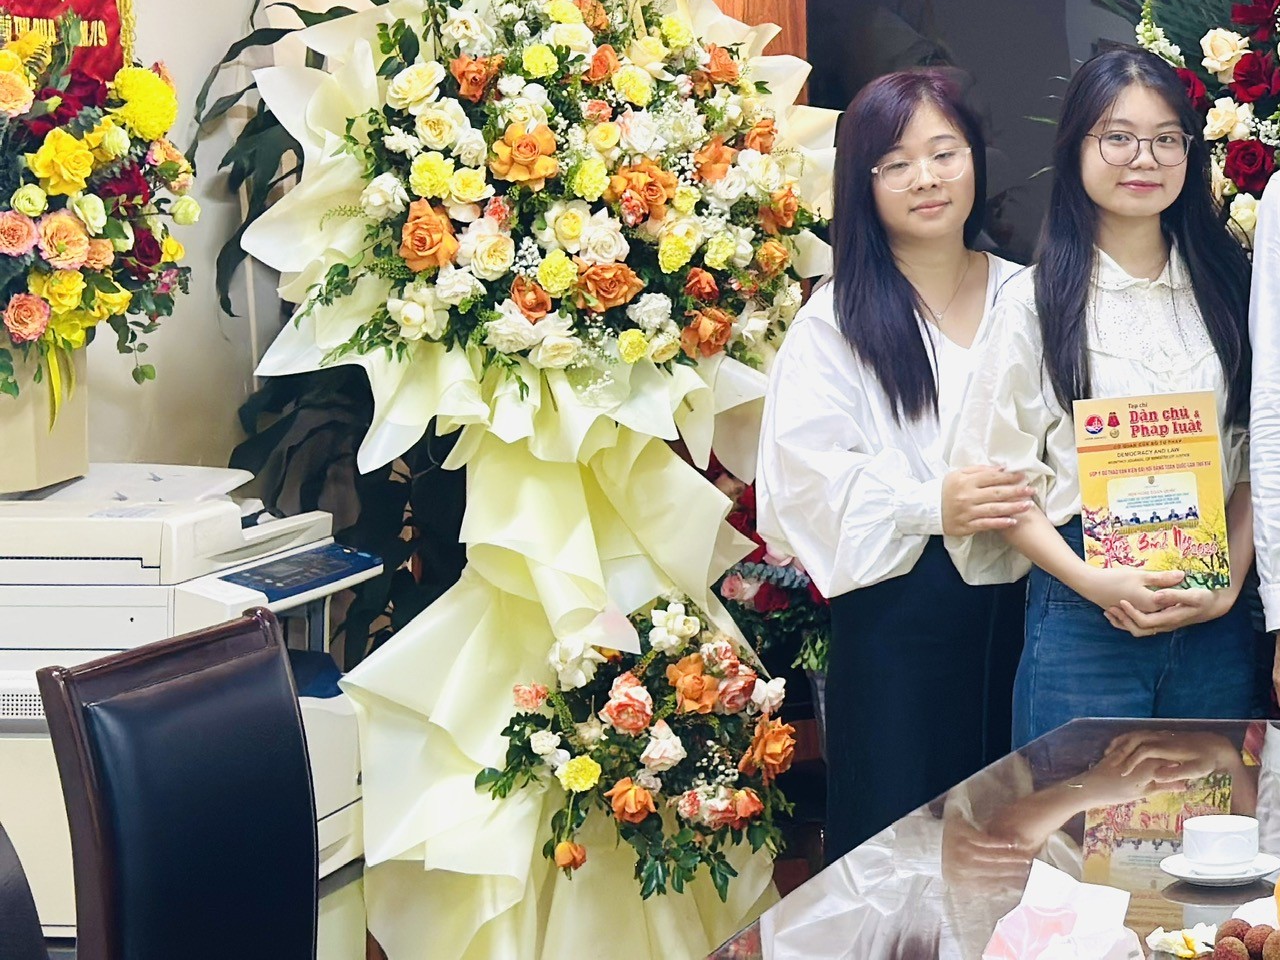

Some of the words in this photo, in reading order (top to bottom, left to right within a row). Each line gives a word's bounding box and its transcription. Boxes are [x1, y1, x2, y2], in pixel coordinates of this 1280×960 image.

[1129, 409, 1159, 424] Dân
[1162, 406, 1190, 421] chủ
[1194, 410, 1200, 418] &
[1130, 423, 1169, 438] Pháp
[1172, 420, 1202, 435] luật
[1117, 449, 1152, 457] DEMOCRACY
